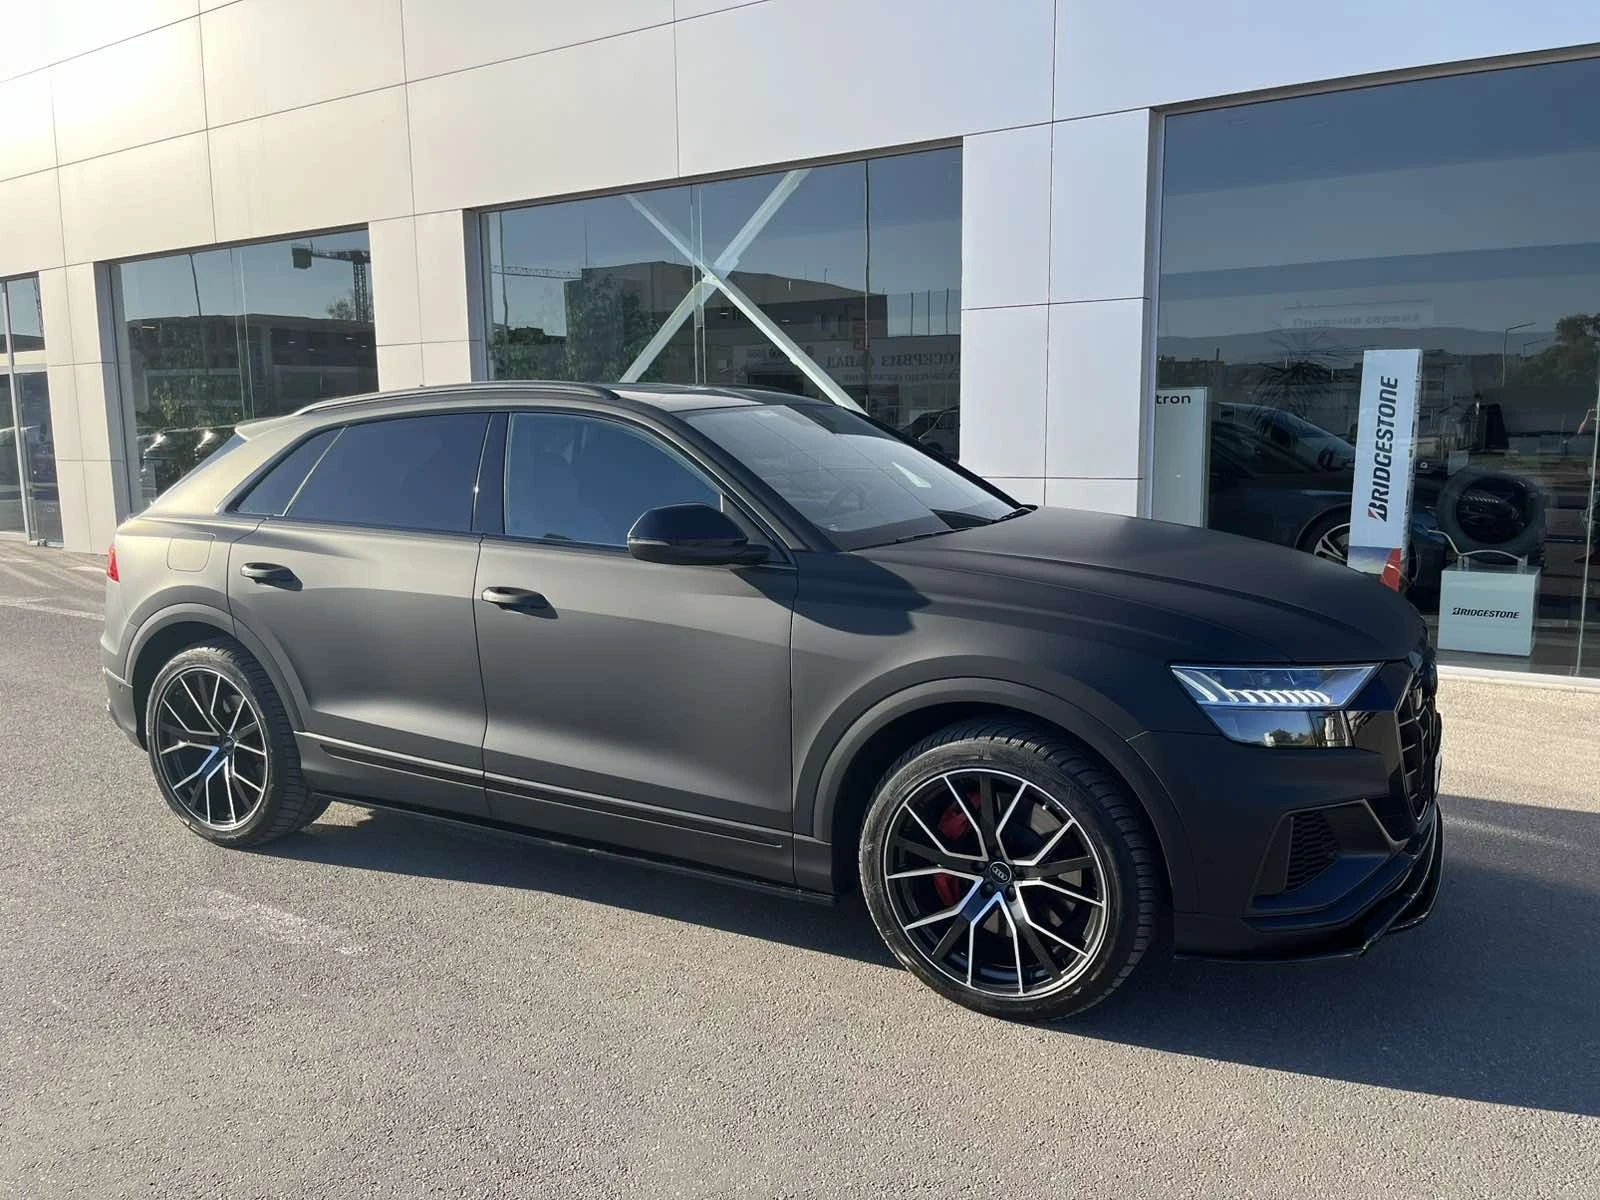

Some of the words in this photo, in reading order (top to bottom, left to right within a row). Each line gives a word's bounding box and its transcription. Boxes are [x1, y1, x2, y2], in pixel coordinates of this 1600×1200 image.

[1156, 394, 1191, 405] tron
[1368, 375, 1398, 522] BRIDGESTONE
[1452, 607, 1520, 619] BRIDGESTONE
